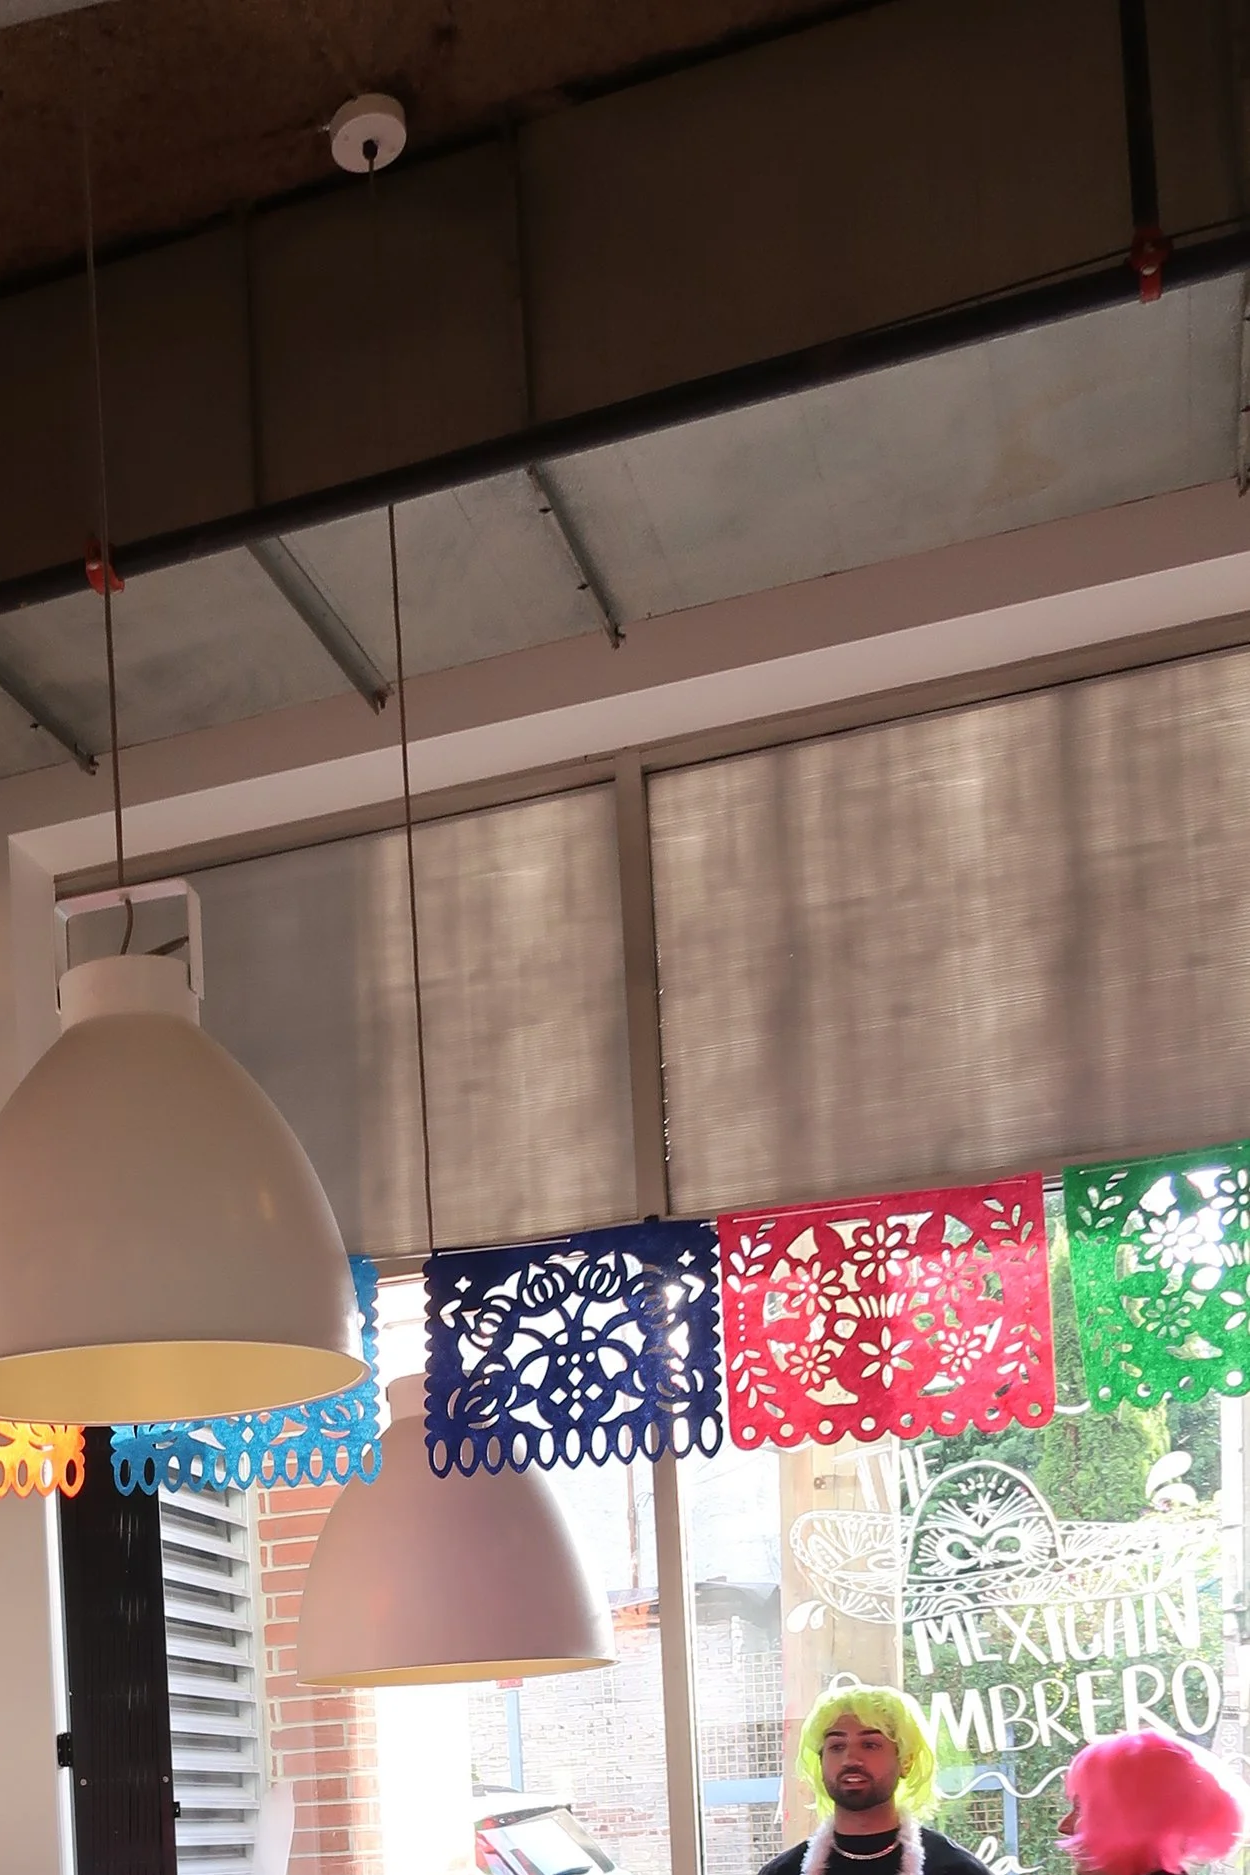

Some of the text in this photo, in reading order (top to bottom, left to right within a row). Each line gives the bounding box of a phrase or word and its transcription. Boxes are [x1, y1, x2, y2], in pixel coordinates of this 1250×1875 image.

[831, 1440, 942, 1512] THE
[912, 1571, 1201, 1675] MEXICAN
[829, 1660, 1221, 1755] MBRERO
